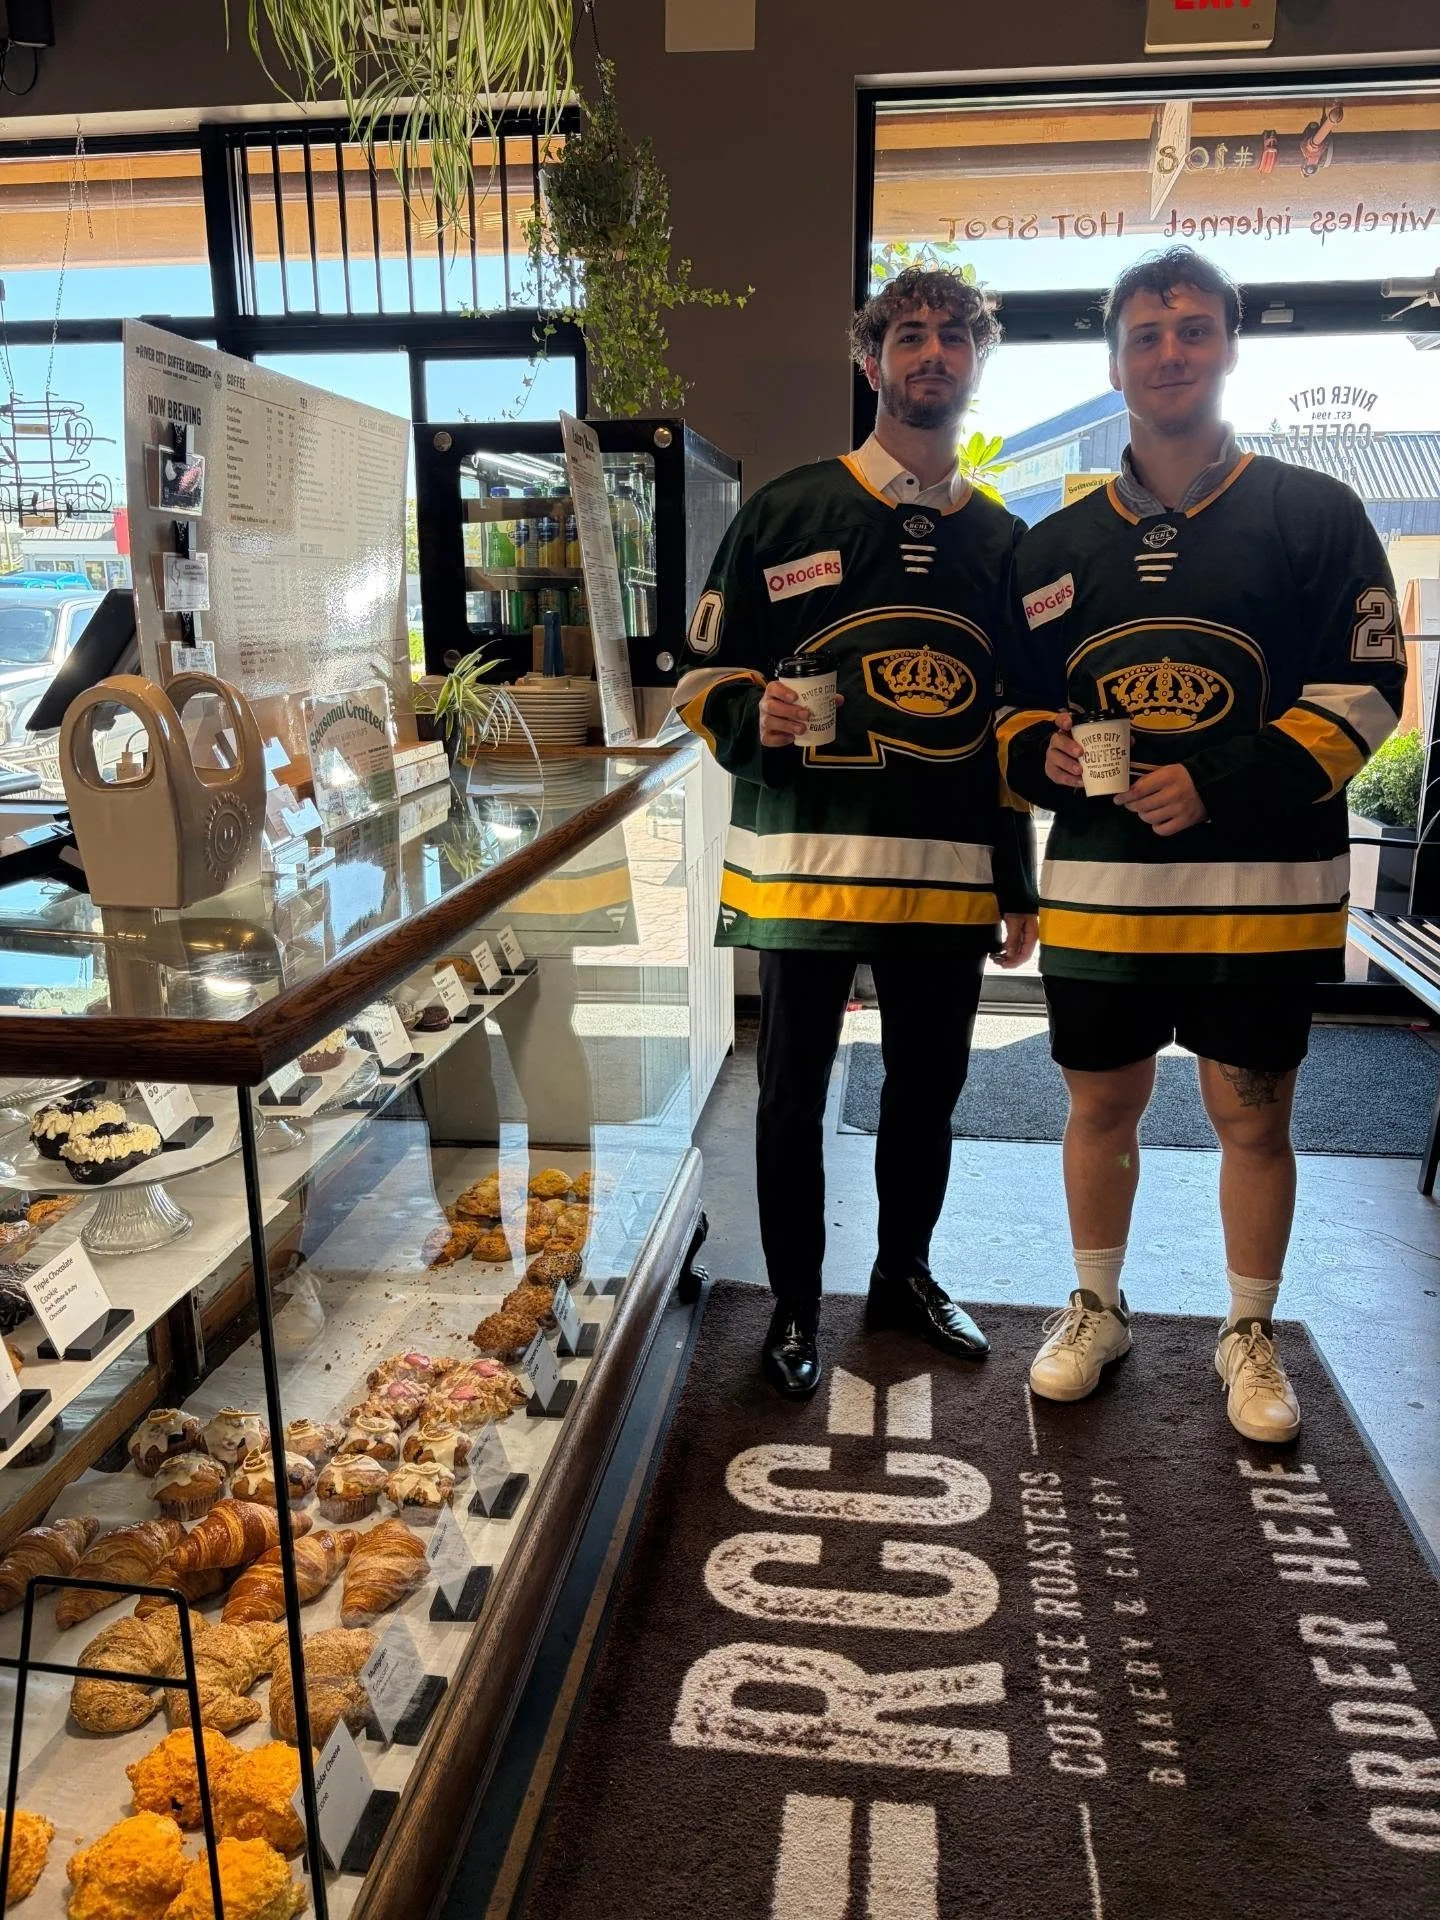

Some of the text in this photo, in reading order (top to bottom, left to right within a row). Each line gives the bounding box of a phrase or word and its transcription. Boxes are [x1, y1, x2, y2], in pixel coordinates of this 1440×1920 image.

[226, 373, 246, 391] COFFEE
[148, 394, 202, 426] NOW BREWING
[785, 561, 841, 587] ROGERS
[1350, 586, 1408, 667] 2
[801, 687, 823, 701] RIVER
[309, 698, 387, 753] Seasonal Crafted
[1081, 732, 1121, 747] RIVER CITY
[1084, 747, 1122, 764] COFFEE
[1089, 767, 1121, 779] ROASTERS
[33, 1258, 74, 1293] Triple Chocolate
[40, 1287, 59, 1305] Cookie
[48, 1304, 68, 1321] Chocolate
[1090, 1476, 1140, 1578] EATERY
[670, 1442, 1011, 1777] RCC
[1018, 1471, 1108, 1777] COFFEE ROASTERS
[1236, 1458, 1440, 1852] ORDER HERE
[1119, 1636, 1187, 1787] BAKERY
[325, 1744, 341, 1772] Cheese
